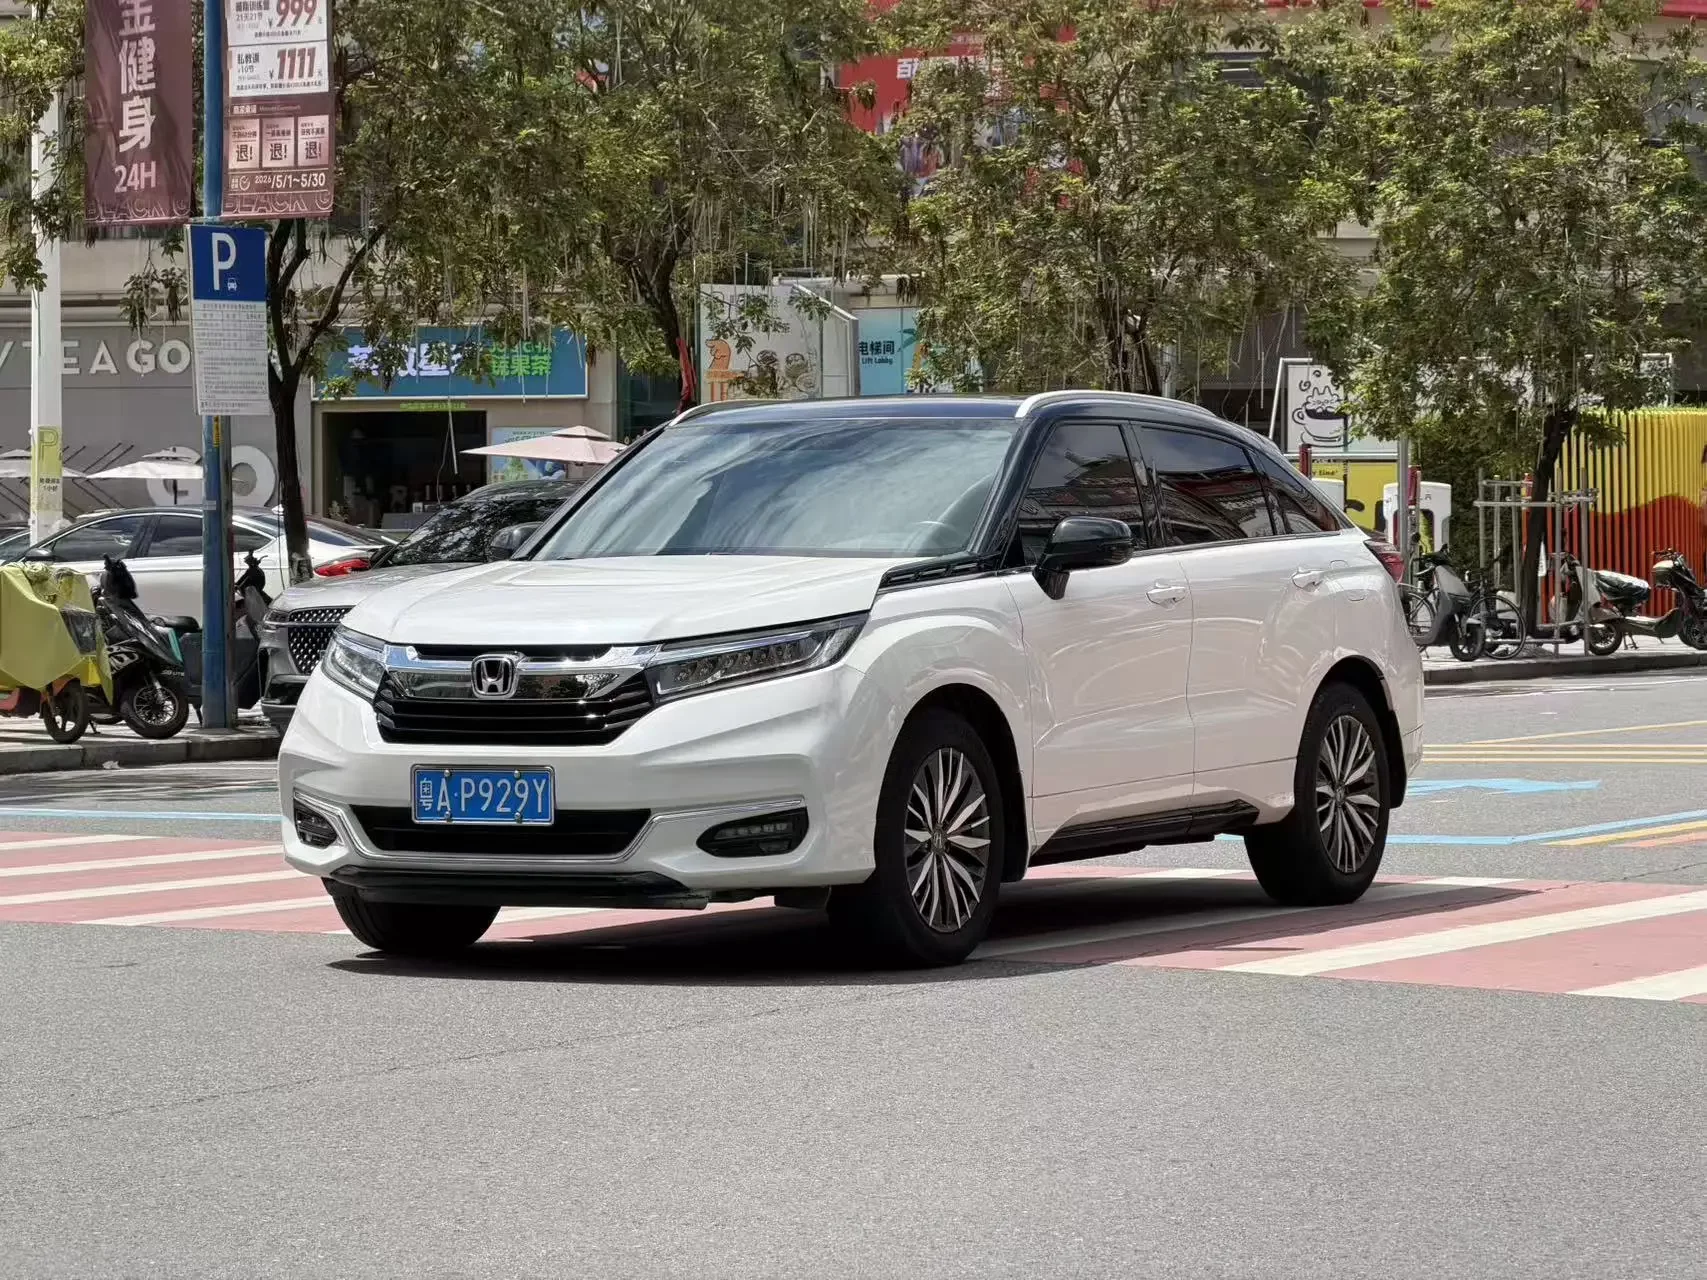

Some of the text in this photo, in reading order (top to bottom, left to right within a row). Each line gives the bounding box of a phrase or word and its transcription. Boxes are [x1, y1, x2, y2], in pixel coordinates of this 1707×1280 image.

[276, 0, 317, 27] 999
[277, 47, 317, 80] 1111
[114, 161, 156, 193] 24H
[211, 232, 237, 291] P
[858, 341, 895, 355] 电梯间
